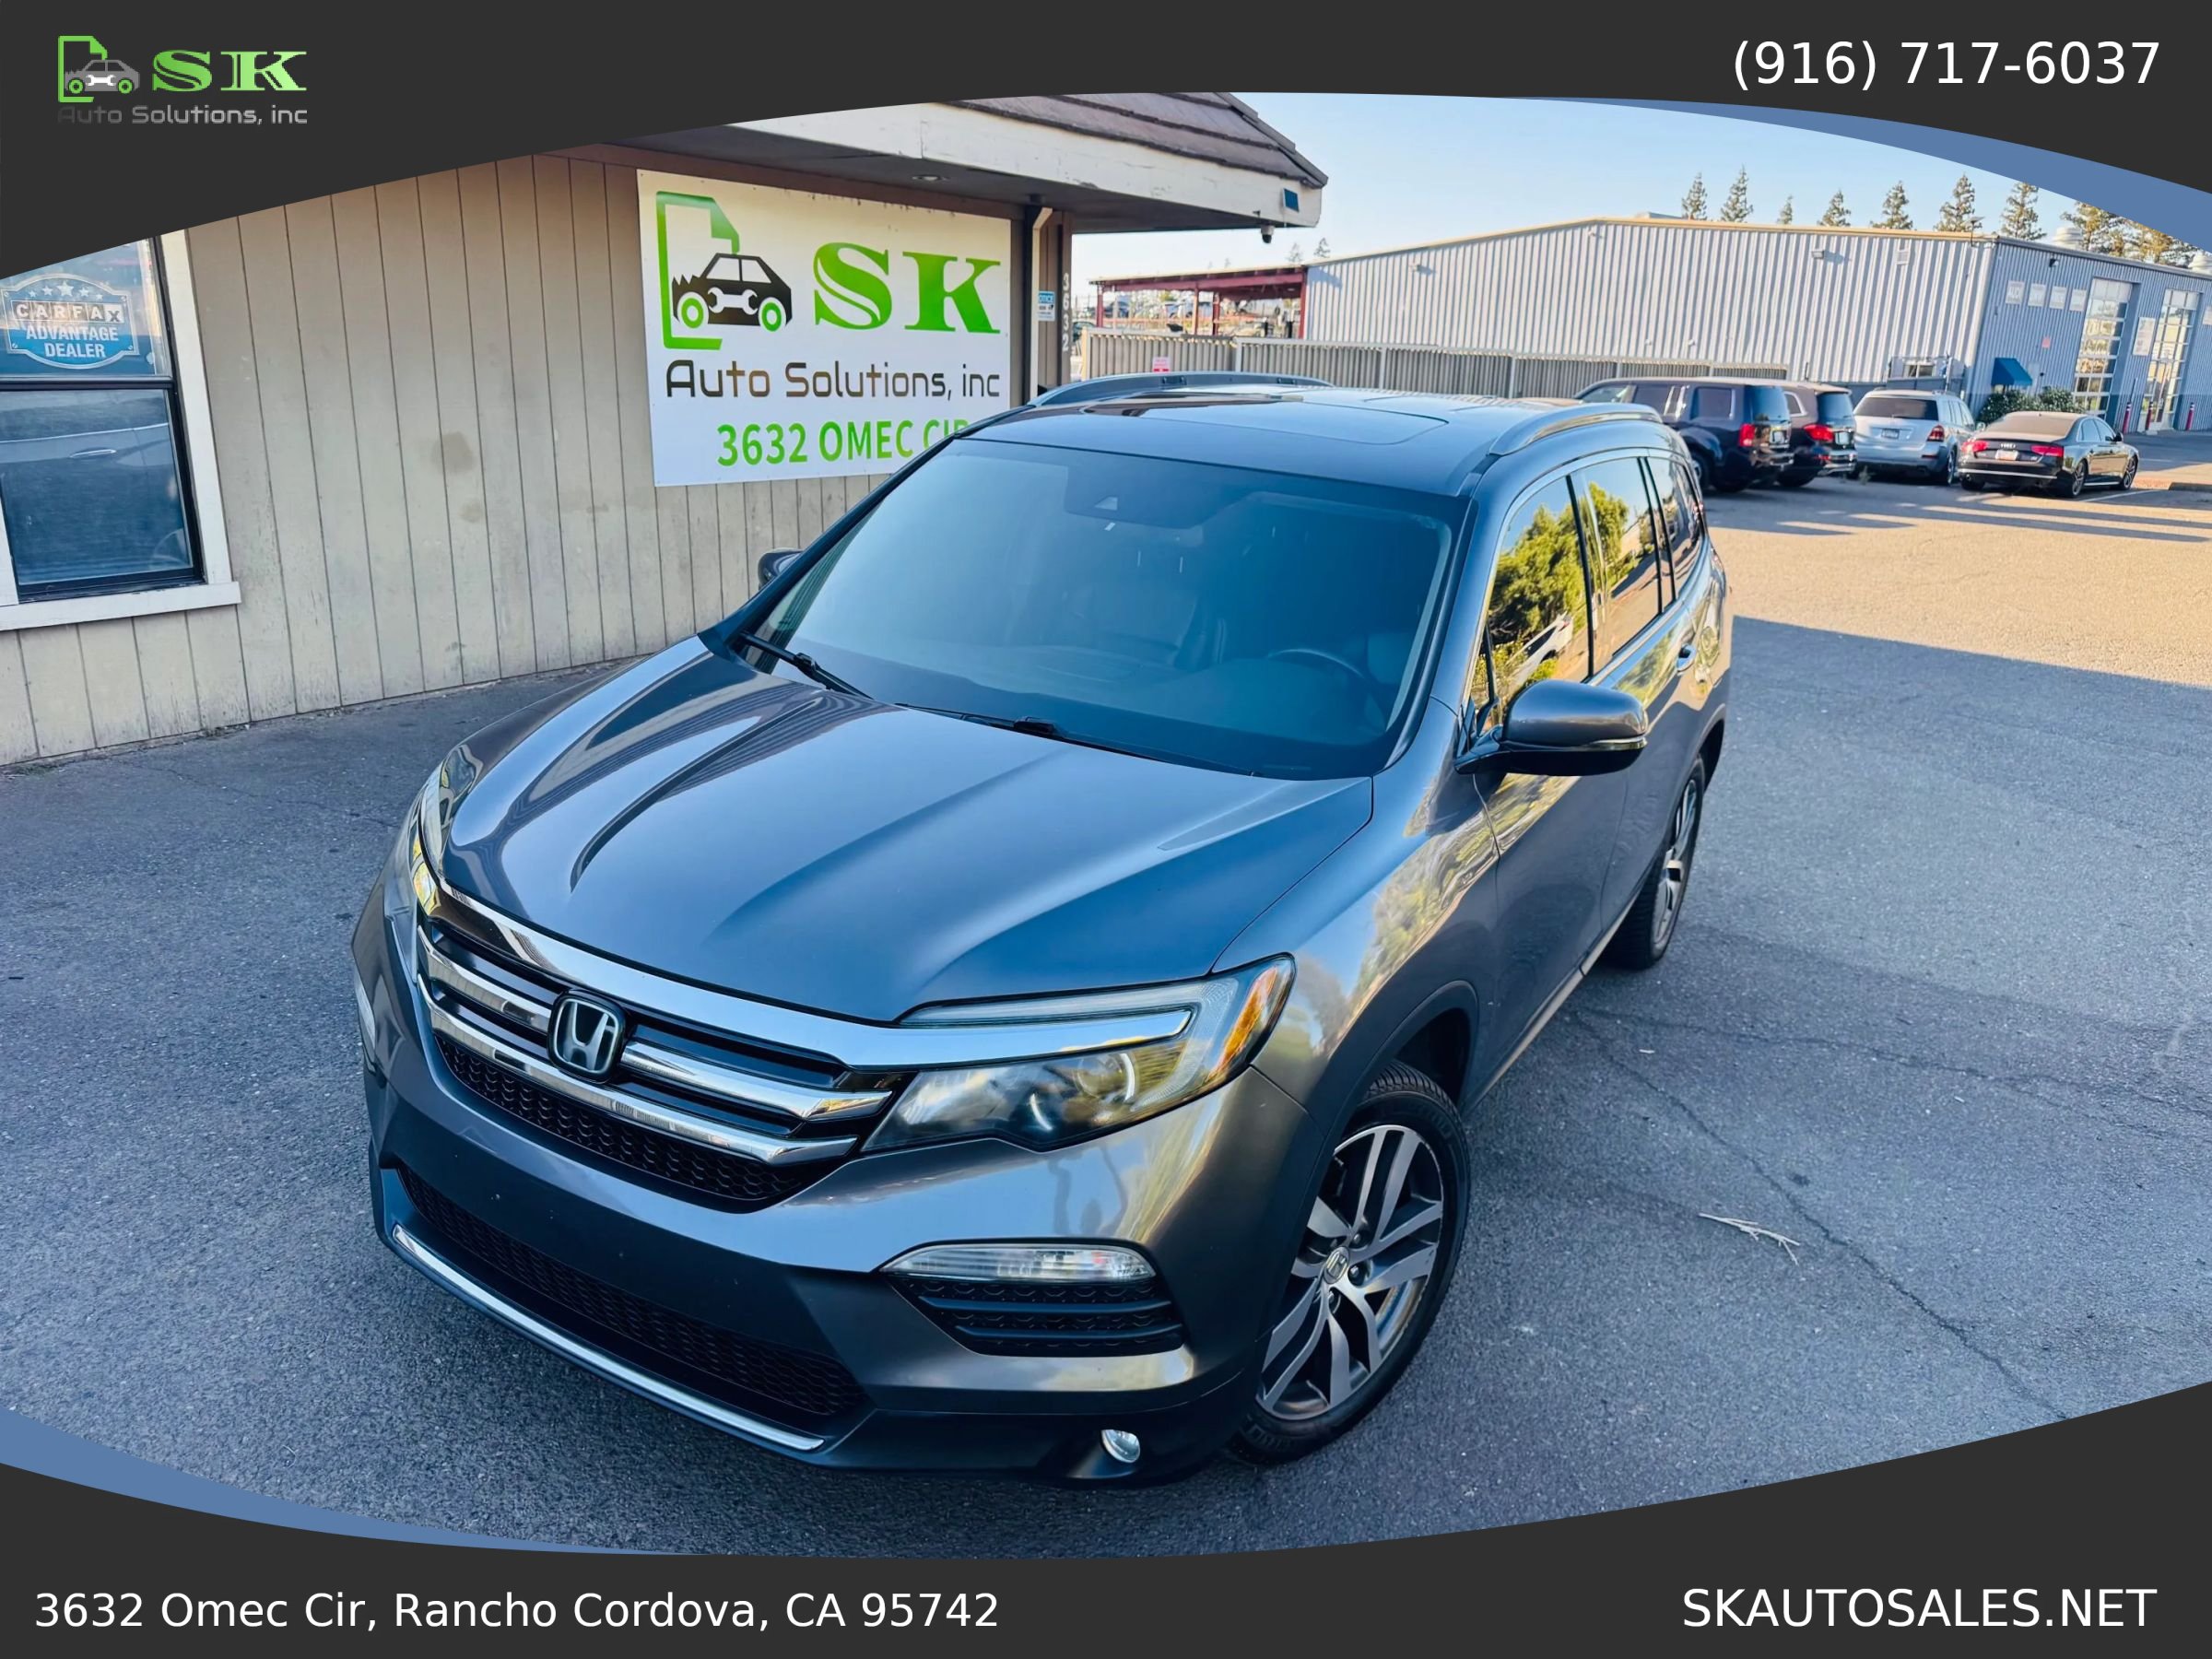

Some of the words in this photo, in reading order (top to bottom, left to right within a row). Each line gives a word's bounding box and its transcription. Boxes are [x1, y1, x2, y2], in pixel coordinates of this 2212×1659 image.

[813, 241, 1001, 334] SK
[16, 304, 120, 323] CARFAX
[26, 324, 119, 342] ADVANTAGE
[1062, 273, 1070, 352] 3632
[45, 343, 107, 359] DEALER
[666, 359, 771, 398] Auto
[785, 361, 952, 401] Solutions,
[962, 363, 1000, 397] inc
[716, 423, 807, 466] 3632
[818, 419, 913, 461] OMEC
